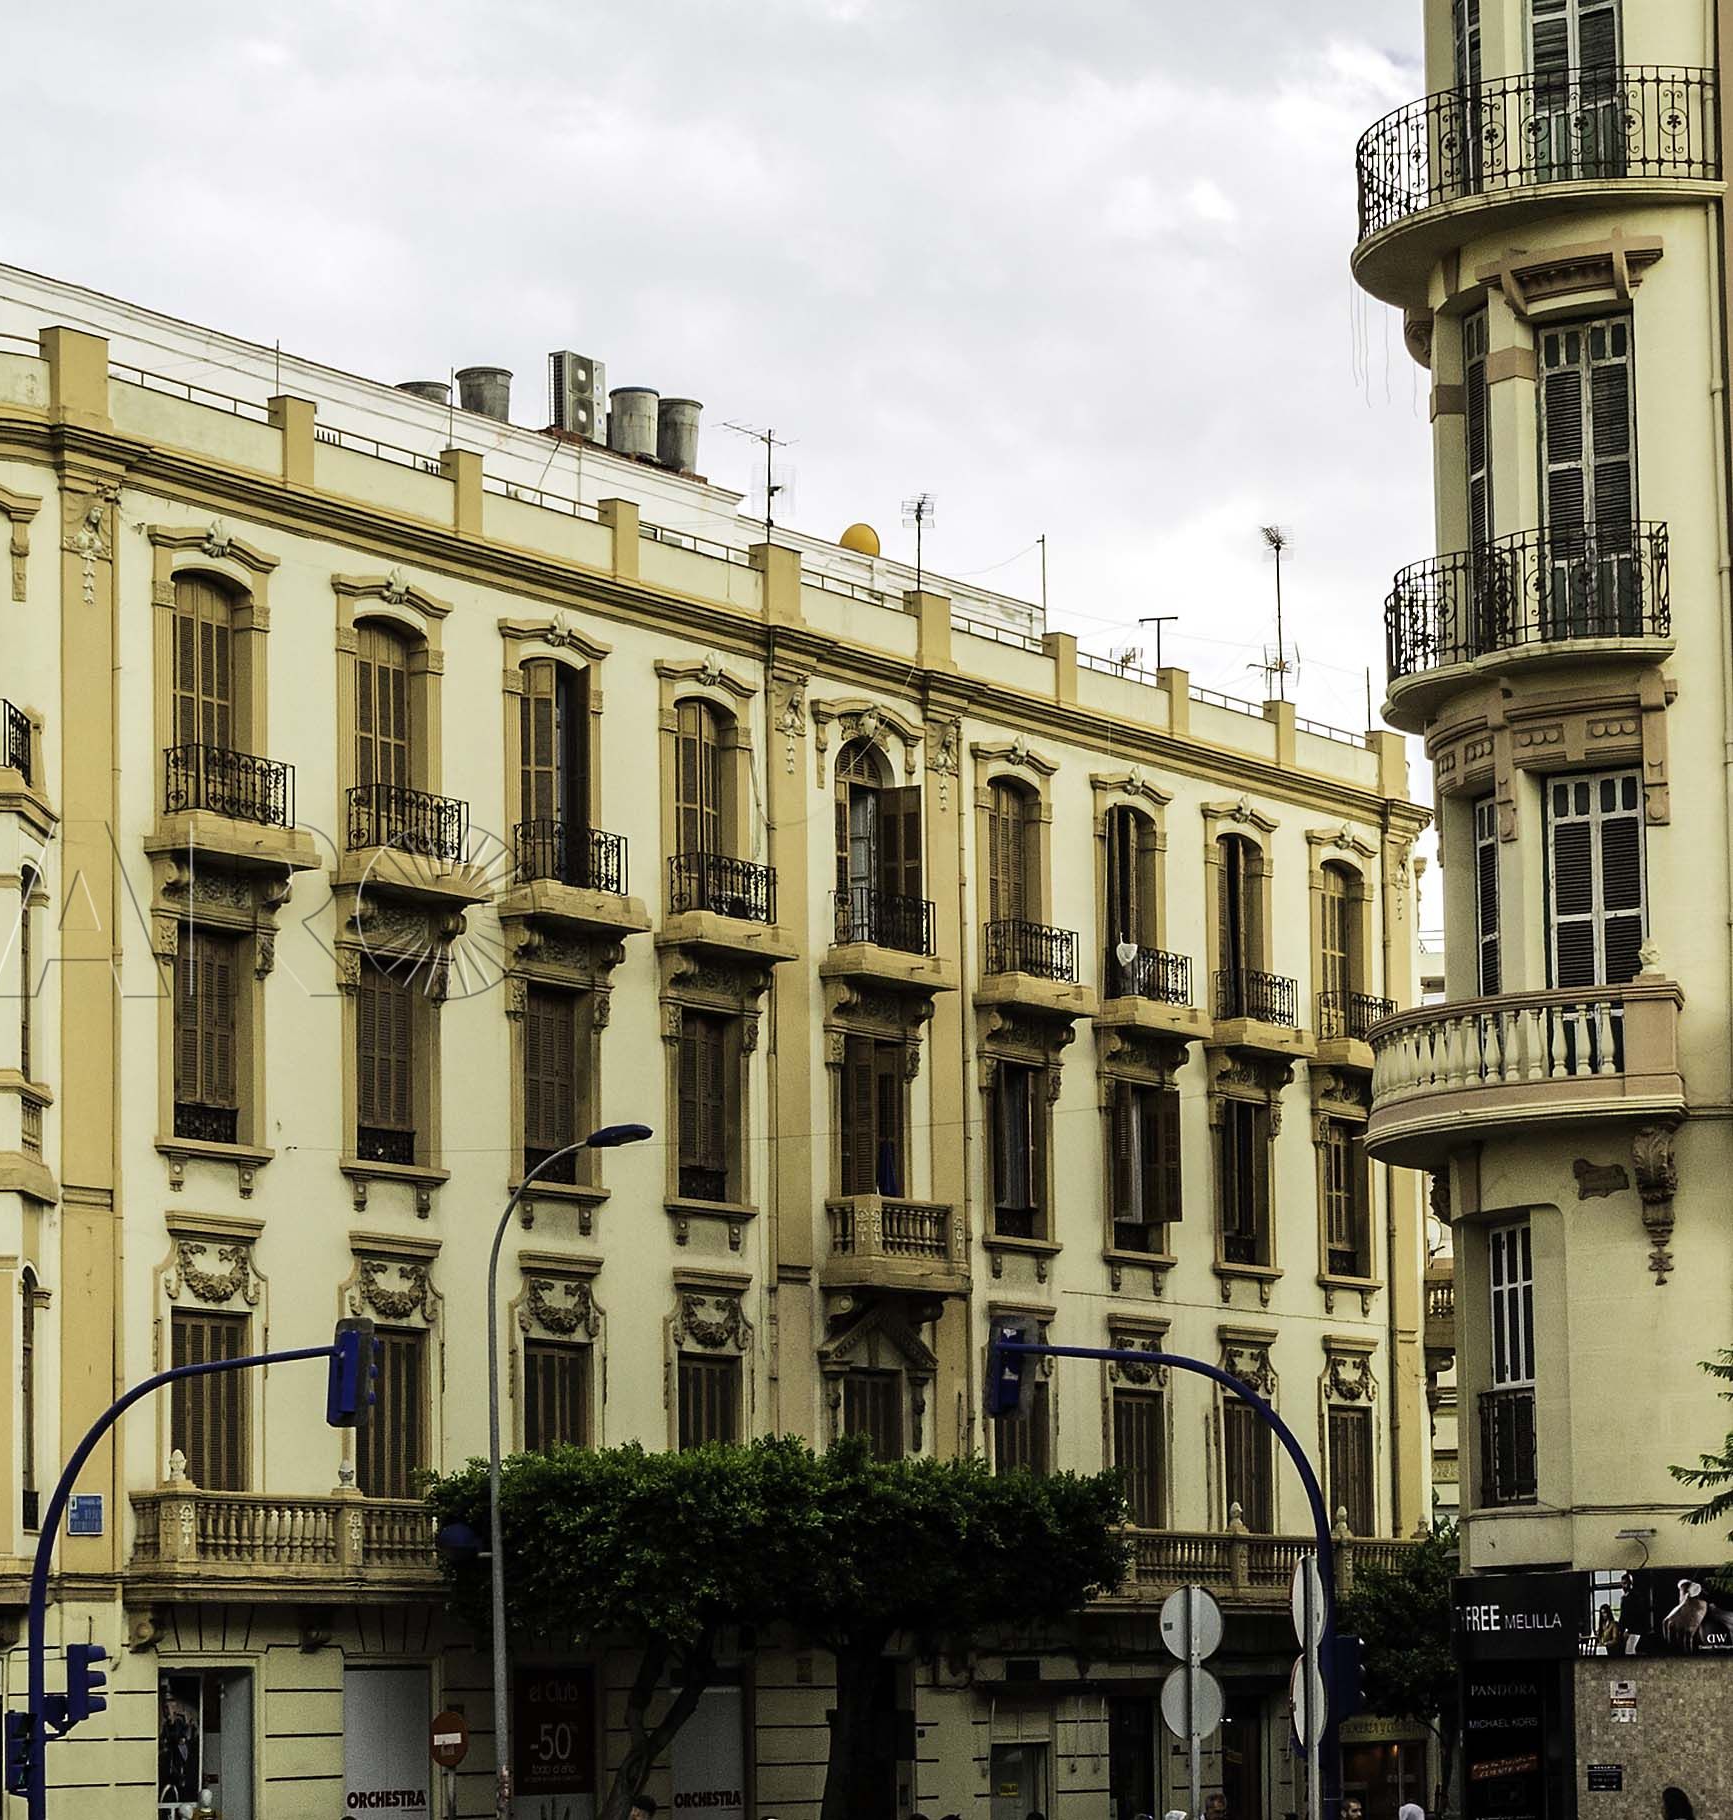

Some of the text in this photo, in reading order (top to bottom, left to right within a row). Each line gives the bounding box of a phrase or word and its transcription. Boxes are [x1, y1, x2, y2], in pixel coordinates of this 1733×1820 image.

[1466, 1605, 1501, 1631] FREE
[1505, 1612, 1562, 1629] MELILLA
[1471, 1683, 1537, 1697] PANDORA
[1469, 1717, 1538, 1729] MICHAEL KORS
[346, 1790, 426, 1809] ORCHESTRA
[673, 1790, 742, 1808] ORCHESTRA
